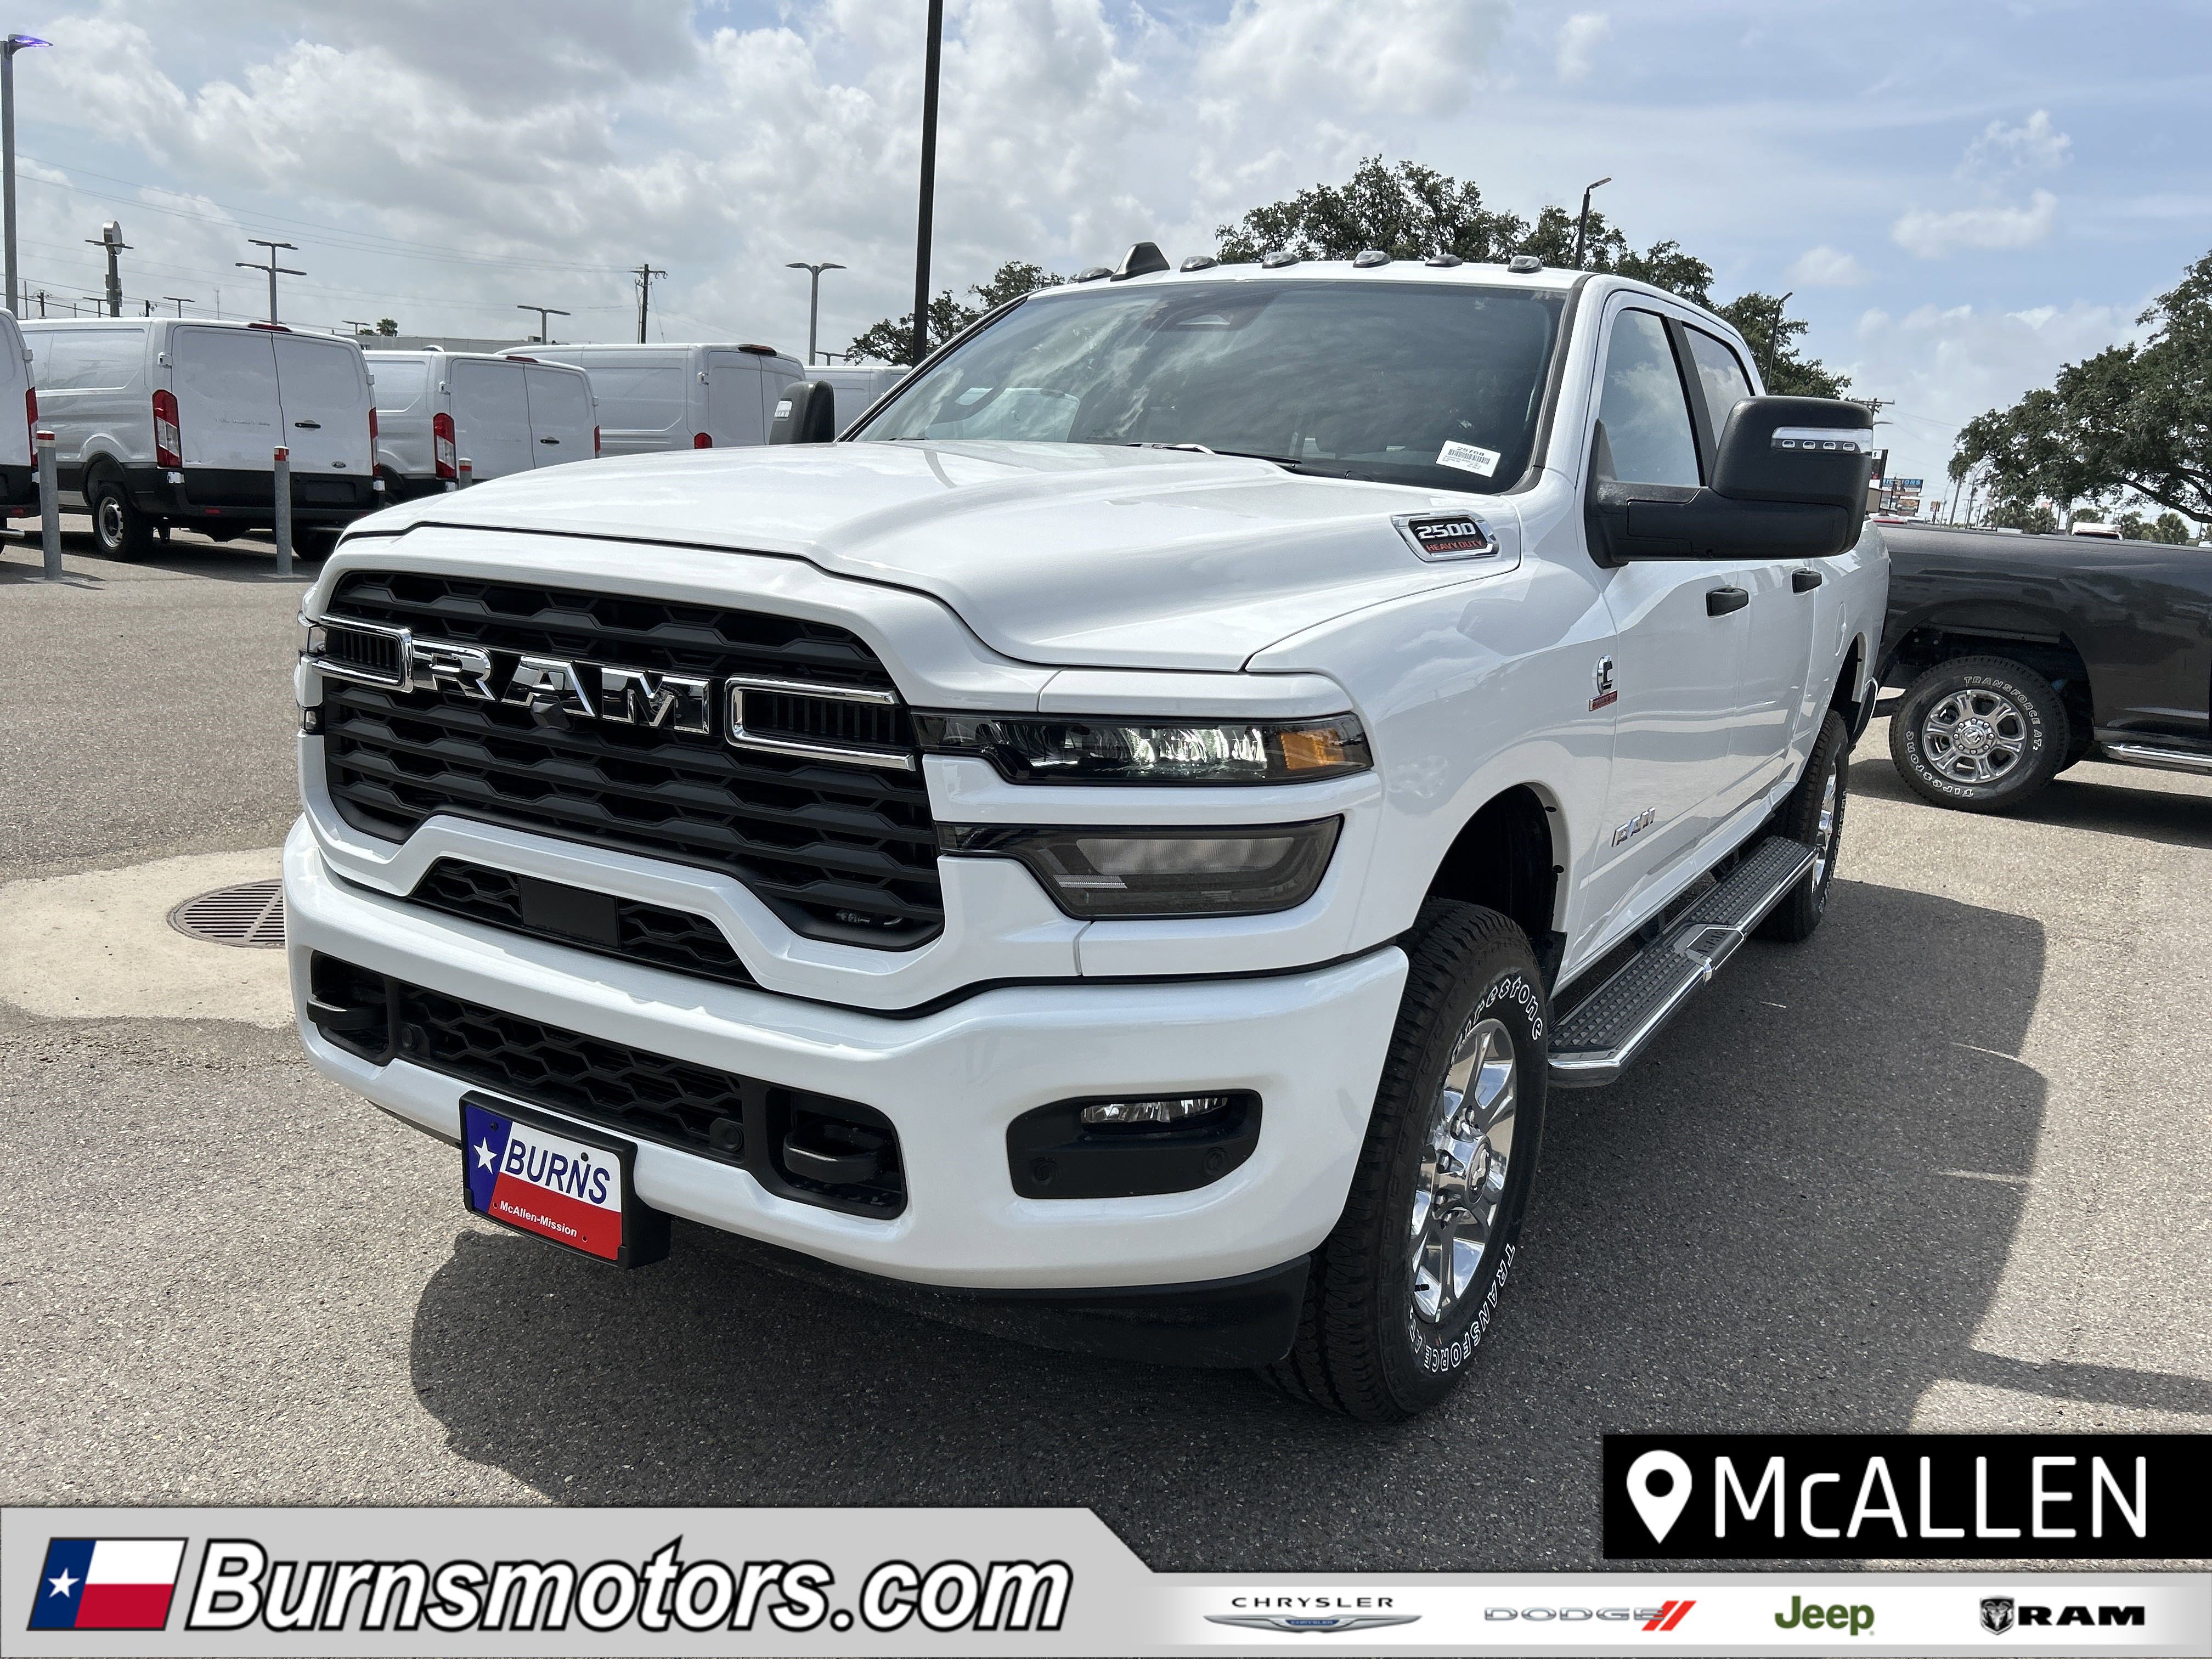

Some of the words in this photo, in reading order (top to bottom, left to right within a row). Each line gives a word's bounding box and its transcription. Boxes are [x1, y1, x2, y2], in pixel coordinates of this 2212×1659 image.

[1415, 523, 1476, 540] 2500
[1426, 542, 1458, 551] HEAVY
[1458, 540, 1483, 549] DUTY
[413, 636, 710, 735] RAM
[1964, 676, 2041, 725] TRANSFORCE
[505, 1138, 611, 1204] BURNS
[500, 1200, 578, 1238] McAllen-Mission
[1424, 1243, 1515, 1373] TRANSFORCE
